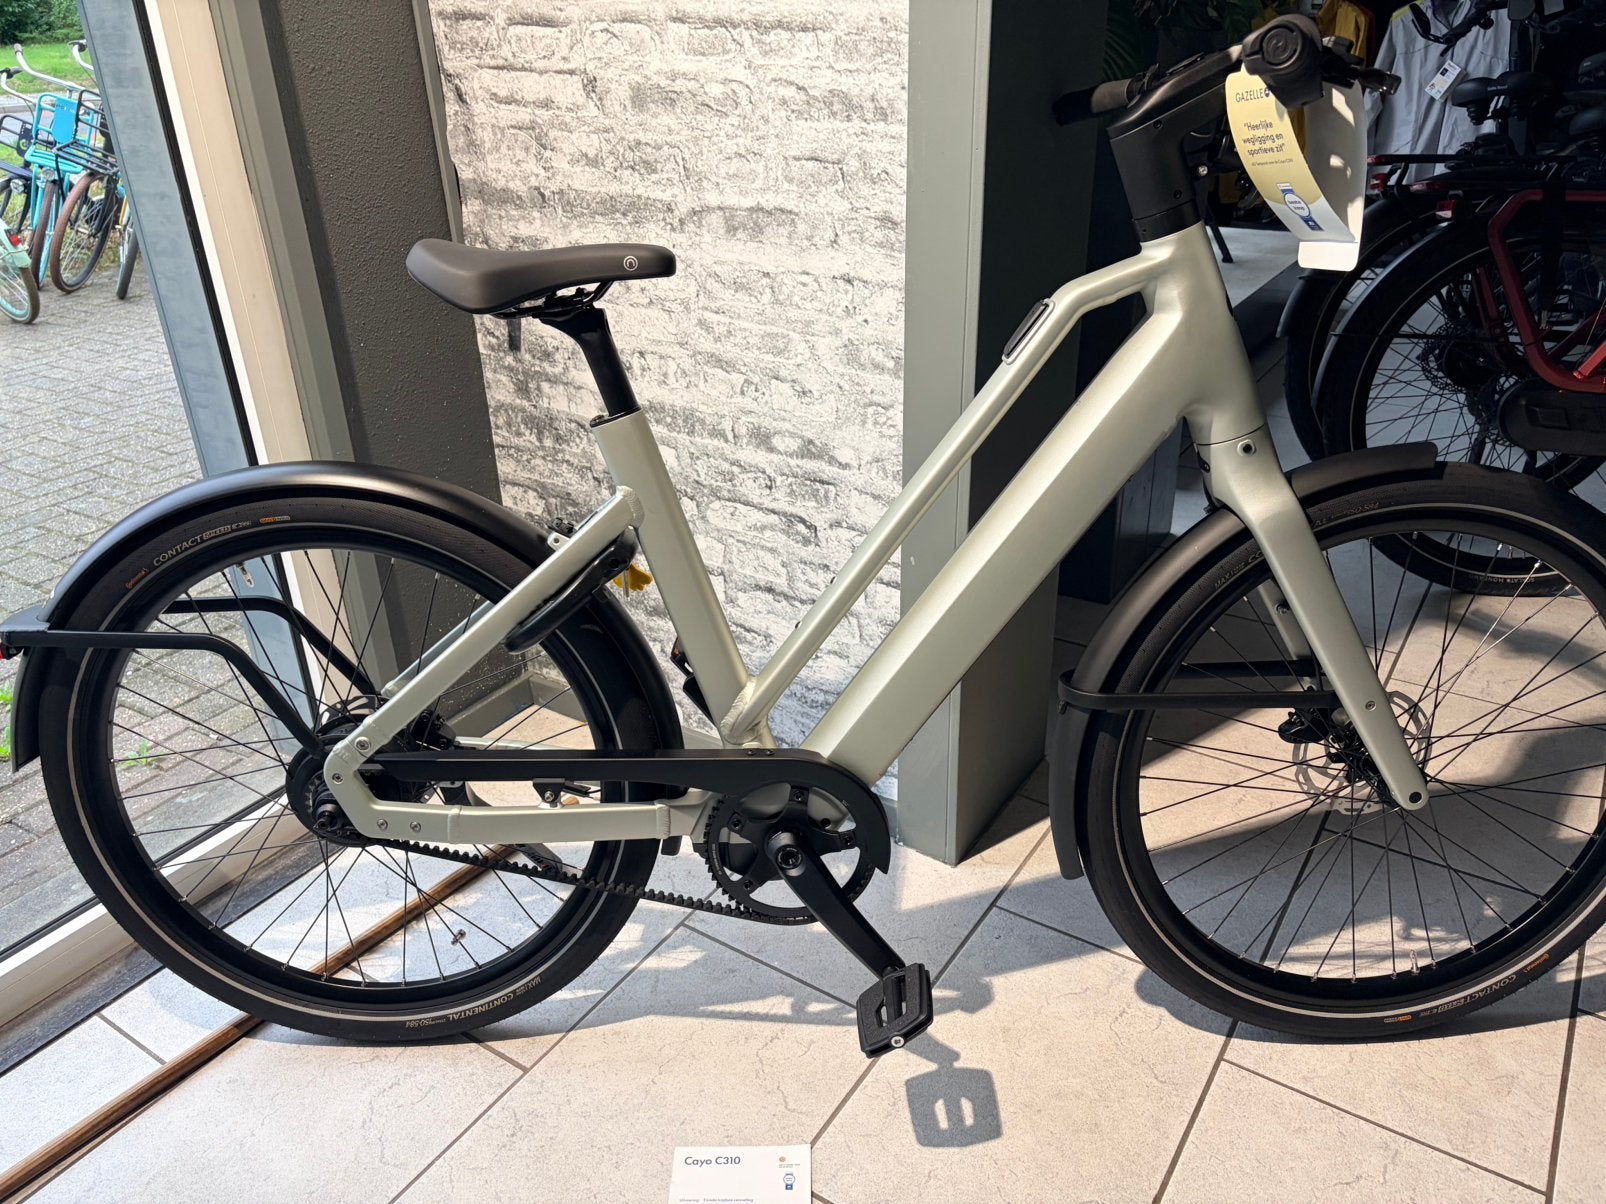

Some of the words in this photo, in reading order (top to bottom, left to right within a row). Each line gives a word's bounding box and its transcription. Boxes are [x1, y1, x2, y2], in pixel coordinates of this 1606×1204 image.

[1235, 88, 1264, 103] GAZELLE
[1242, 133, 1275, 146] wegligging
[1275, 133, 1284, 141] en
[1247, 146, 1275, 157] sportieve
[153, 534, 202, 567] CONTACT
[1466, 974, 1517, 1003] CONTACT
[447, 992, 514, 1021] CONTINENTAL
[684, 1156, 713, 1168] Cayo
[715, 1156, 741, 1165] C310
